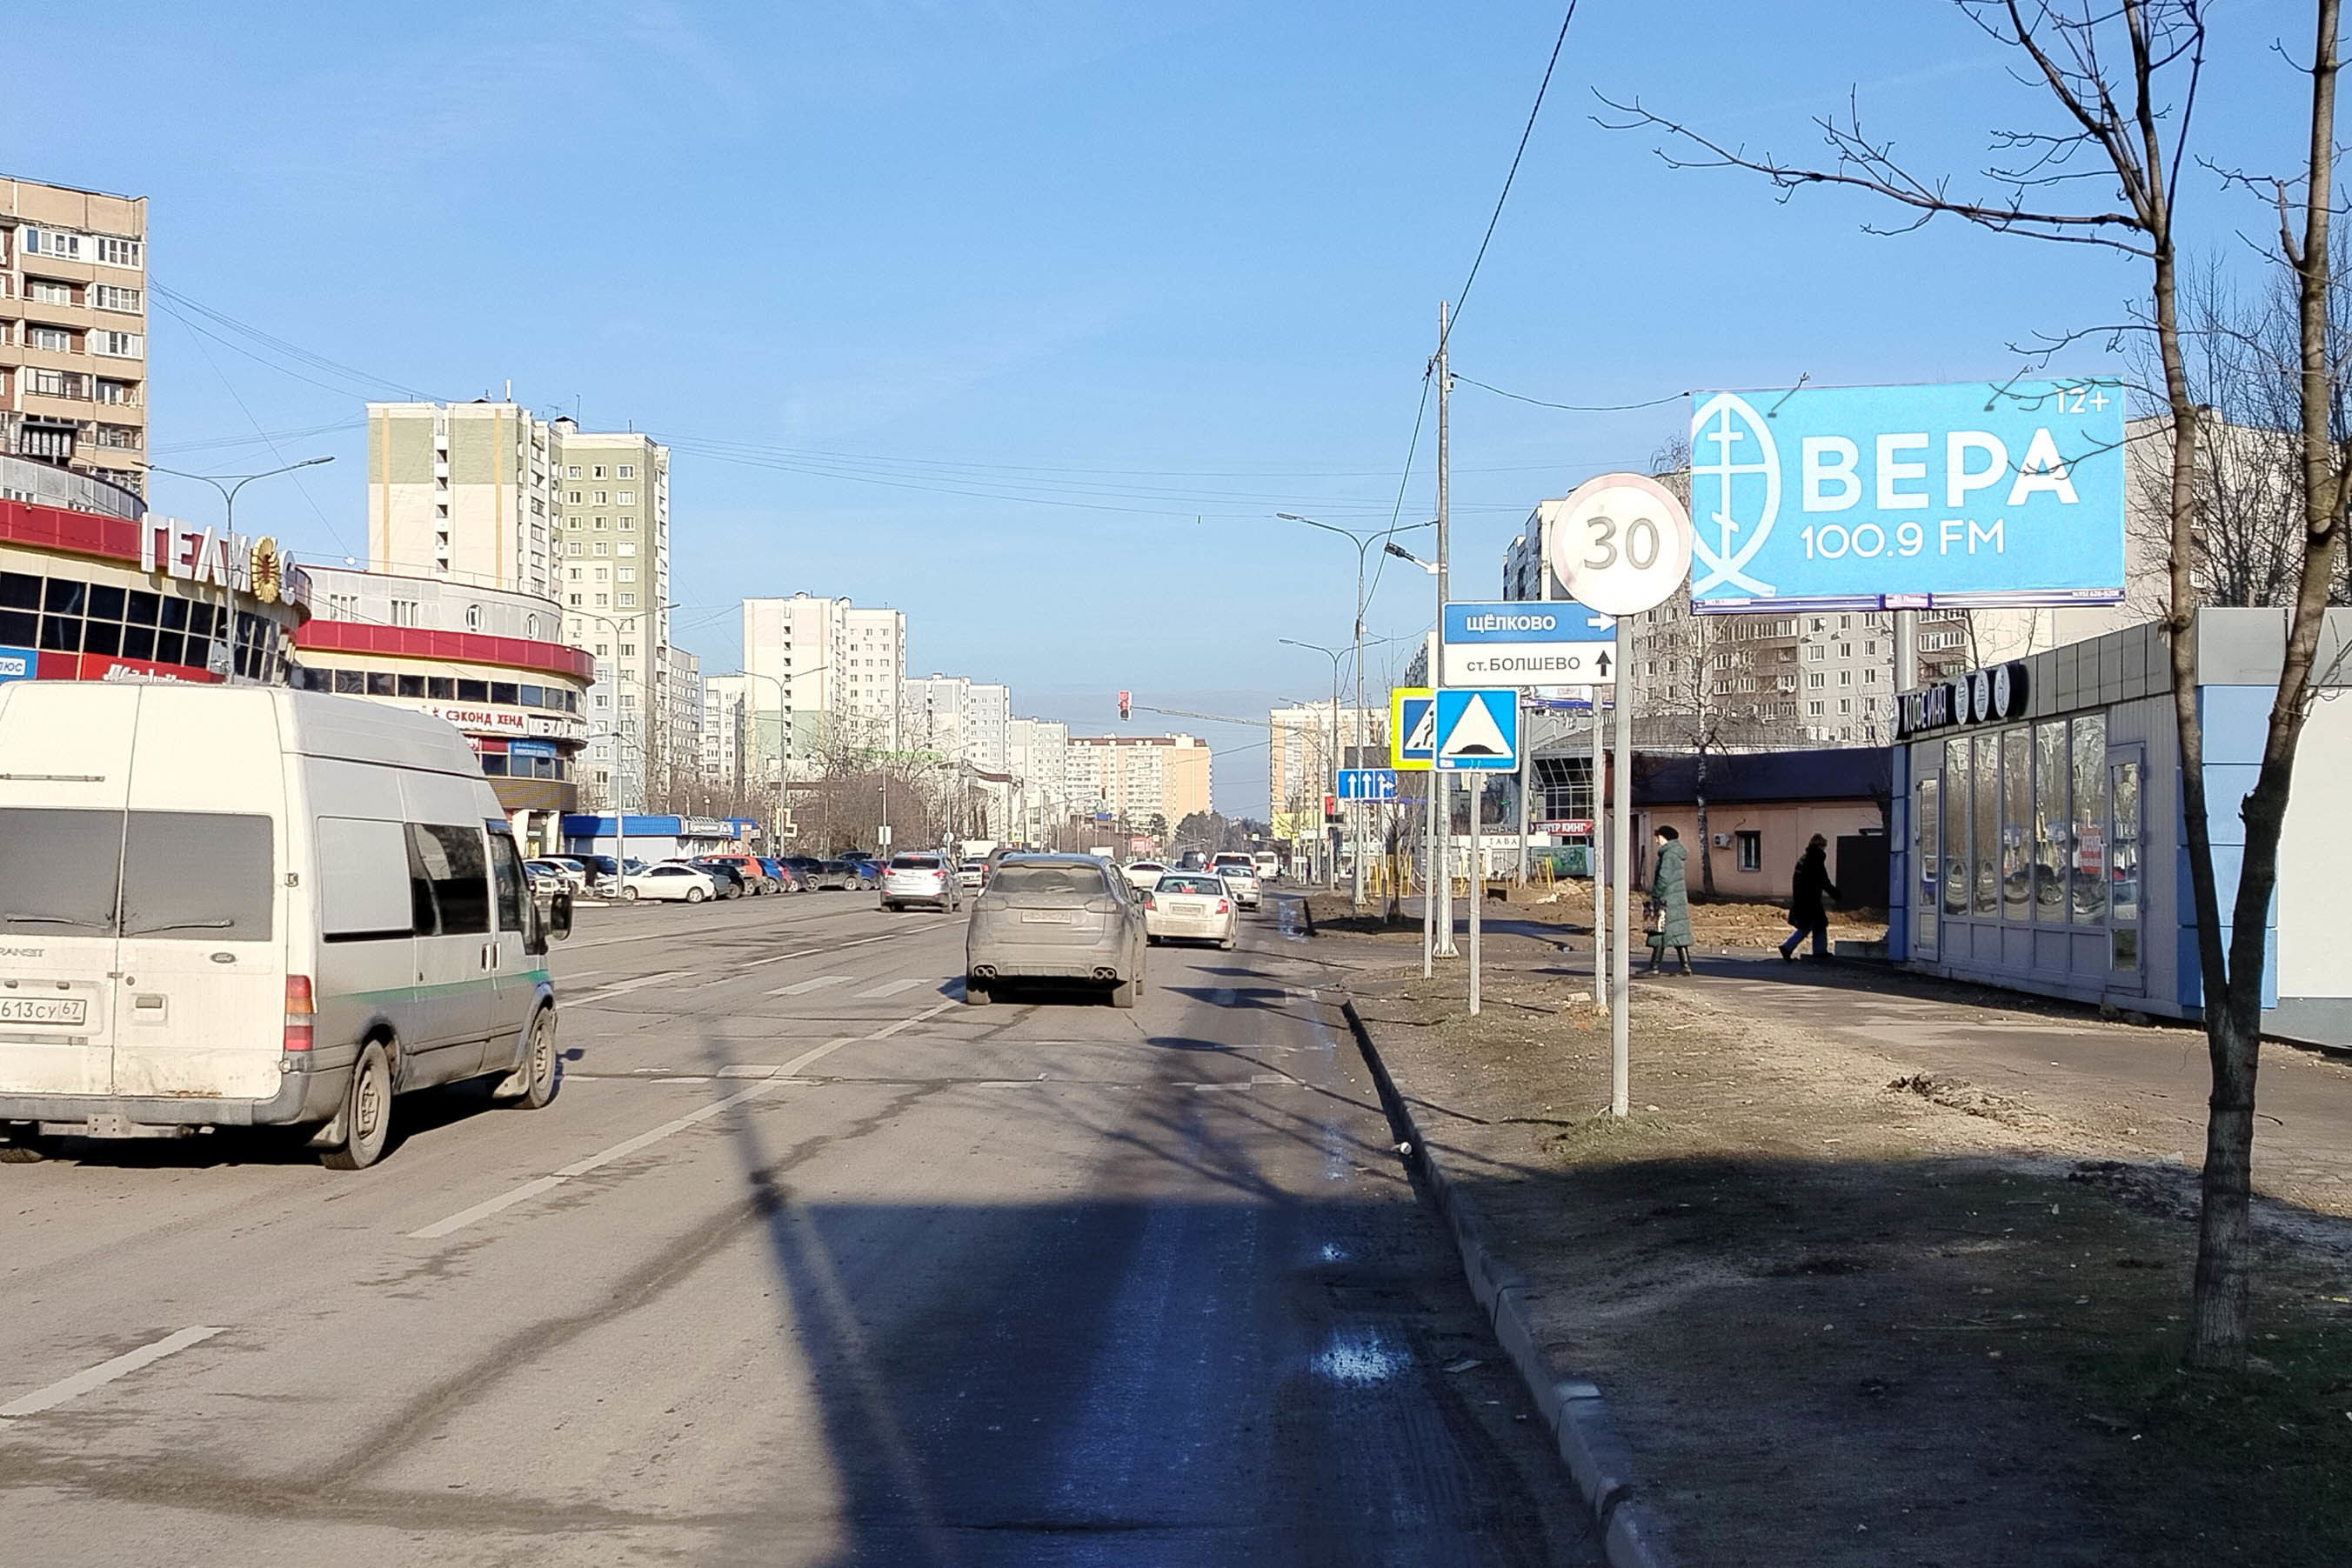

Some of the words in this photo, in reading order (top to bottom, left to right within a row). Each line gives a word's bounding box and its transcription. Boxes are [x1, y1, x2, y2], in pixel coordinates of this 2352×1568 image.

[2055, 387, 2110, 413] 12+
[1802, 428, 2079, 512] ВЕРА
[1584, 517, 1660, 570] 30
[1801, 522, 1924, 559] 100.9
[1940, 518, 2004, 556] FM
[1466, 613, 1556, 633] ЩЁЛКОВО
[446, 710, 491, 725] СЭКОНД
[497, 713, 524, 728] ХЕНД
[63, 1003, 79, 1015] 67
